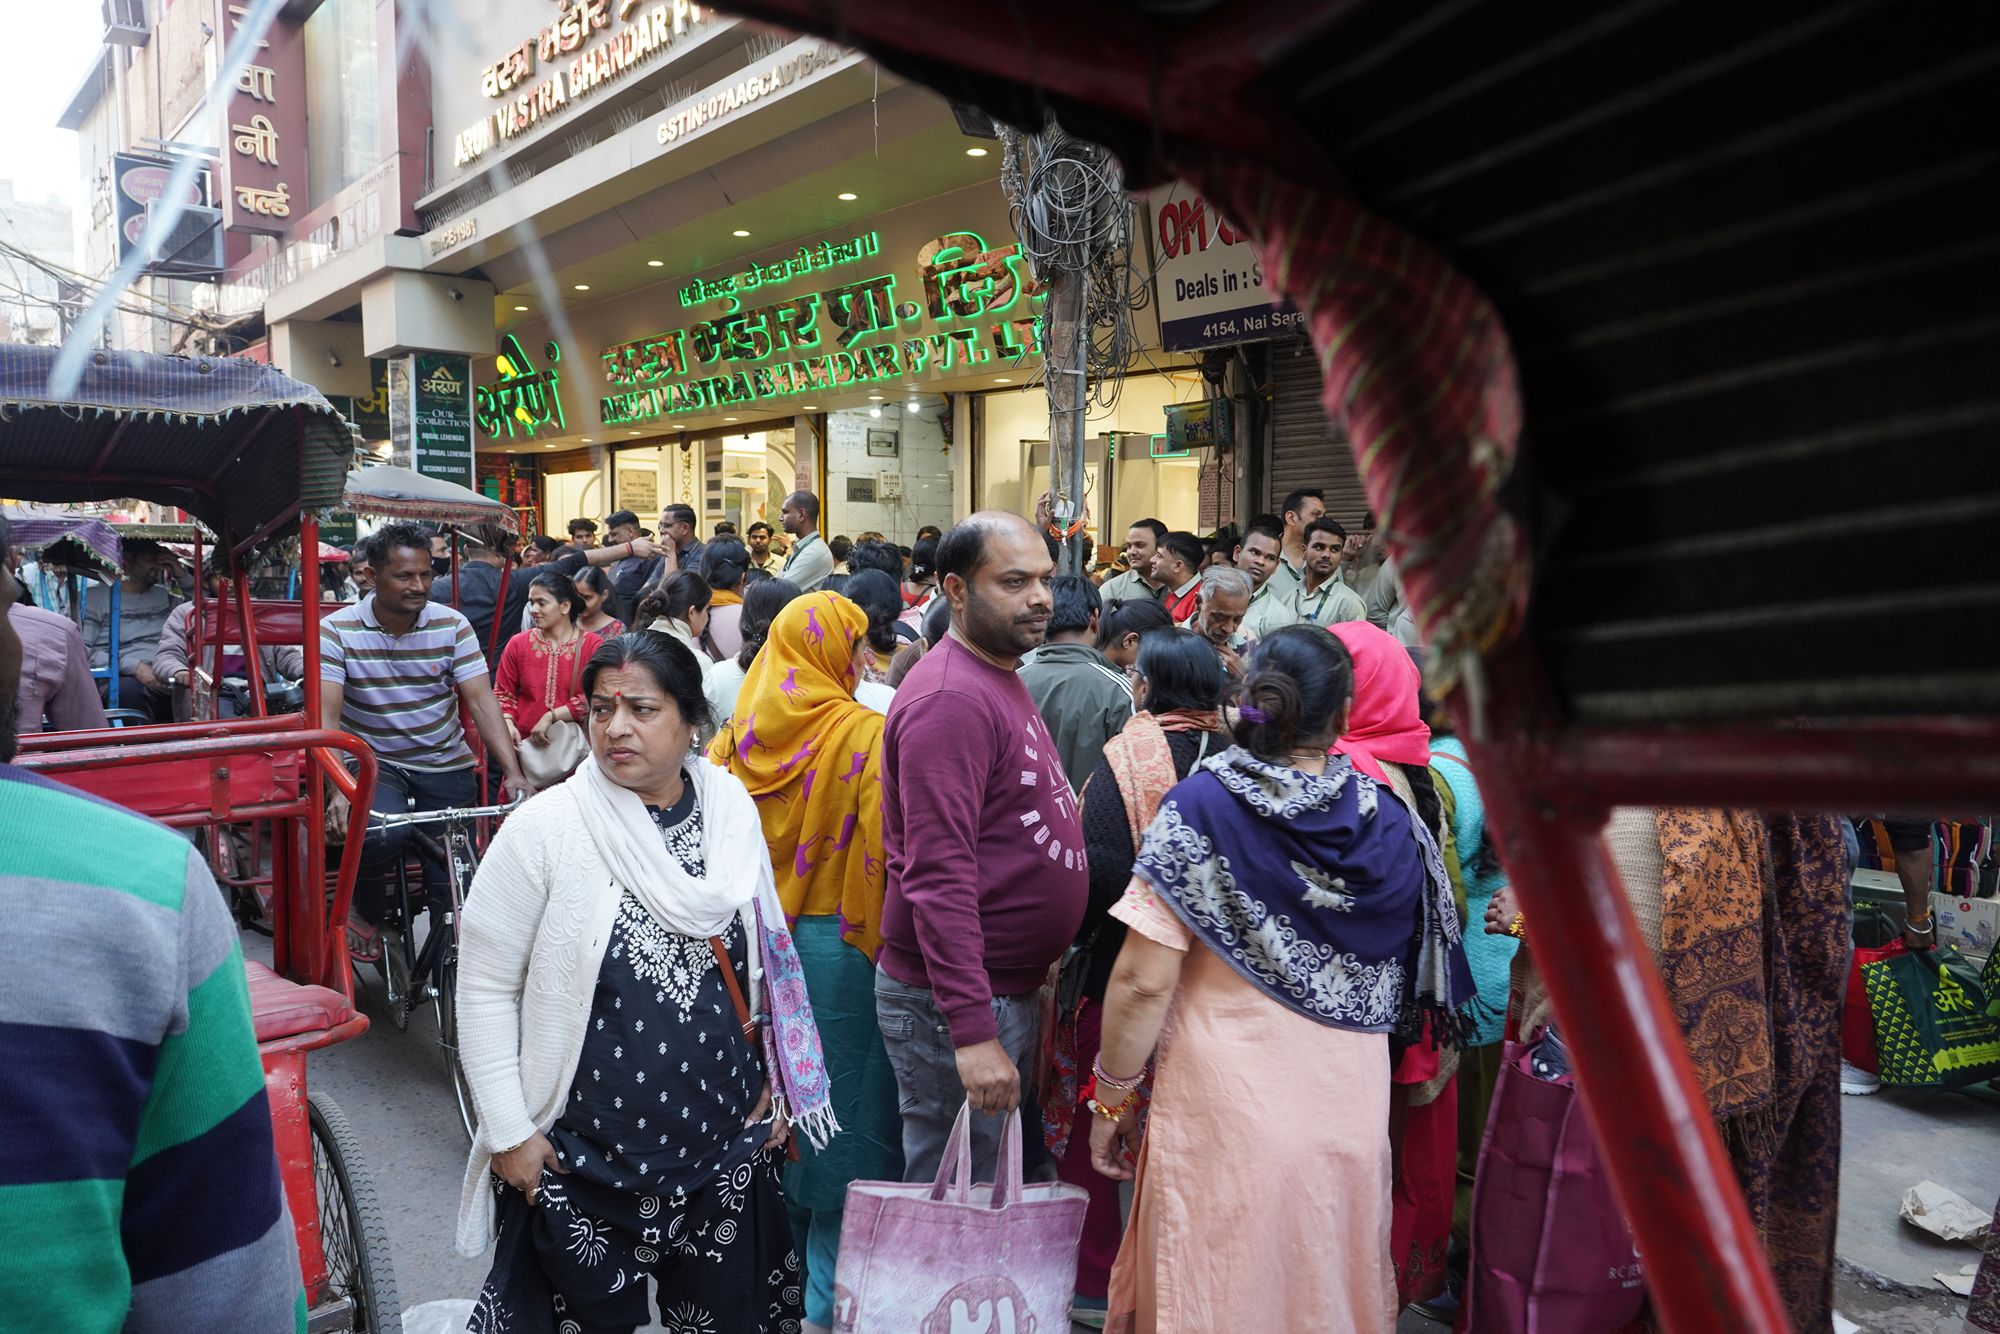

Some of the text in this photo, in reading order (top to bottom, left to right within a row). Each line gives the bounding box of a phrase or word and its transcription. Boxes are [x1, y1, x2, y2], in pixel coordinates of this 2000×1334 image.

[454, 113, 497, 168] ARUN
[496, 71, 567, 140] VASTRA
[569, 4, 672, 98] BHANDAR
[656, 42, 857, 145] GSTIN:07AAGCA0164L
[1175, 273, 1219, 302] Deals
[1223, 269, 1238, 293] in
[1203, 320, 1240, 338] 4154,
[1244, 314, 1267, 332] Nai
[600, 316, 1045, 424] ARUN VASTRA BHANDAR PVT. LT
[416, 415, 470, 428] COLLECTION
[431, 408, 454, 419] OUR
